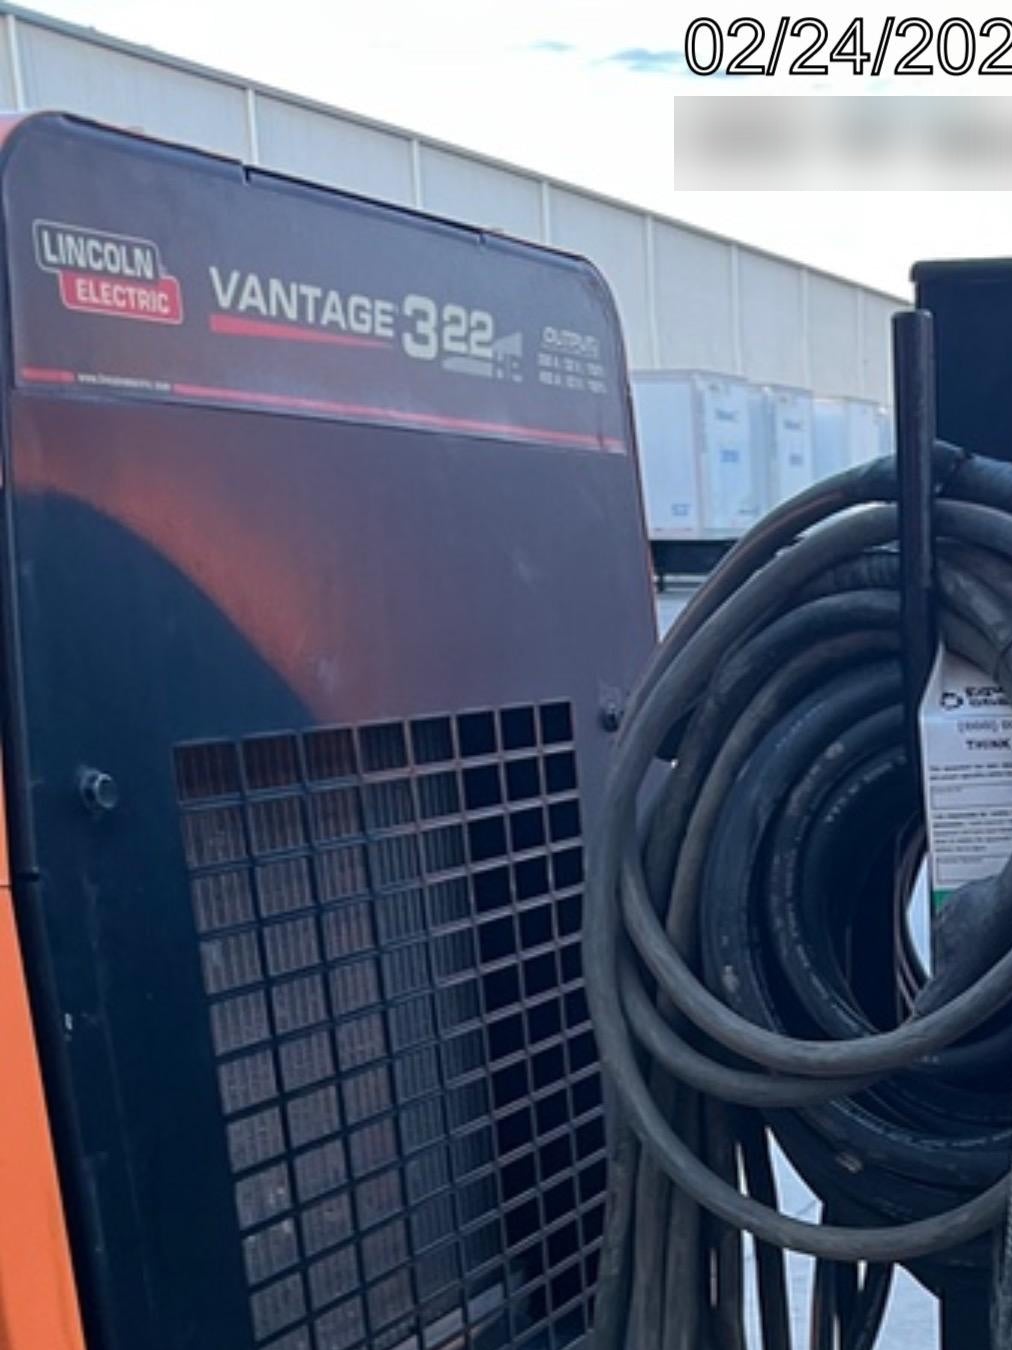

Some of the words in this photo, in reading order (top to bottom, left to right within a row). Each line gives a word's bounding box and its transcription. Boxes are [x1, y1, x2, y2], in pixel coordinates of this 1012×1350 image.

[41, 228, 155, 280] LINCOLN
[75, 277, 170, 315] ELECTRIC
[209, 266, 395, 338] VANTAGE
[402, 293, 493, 361] 322
